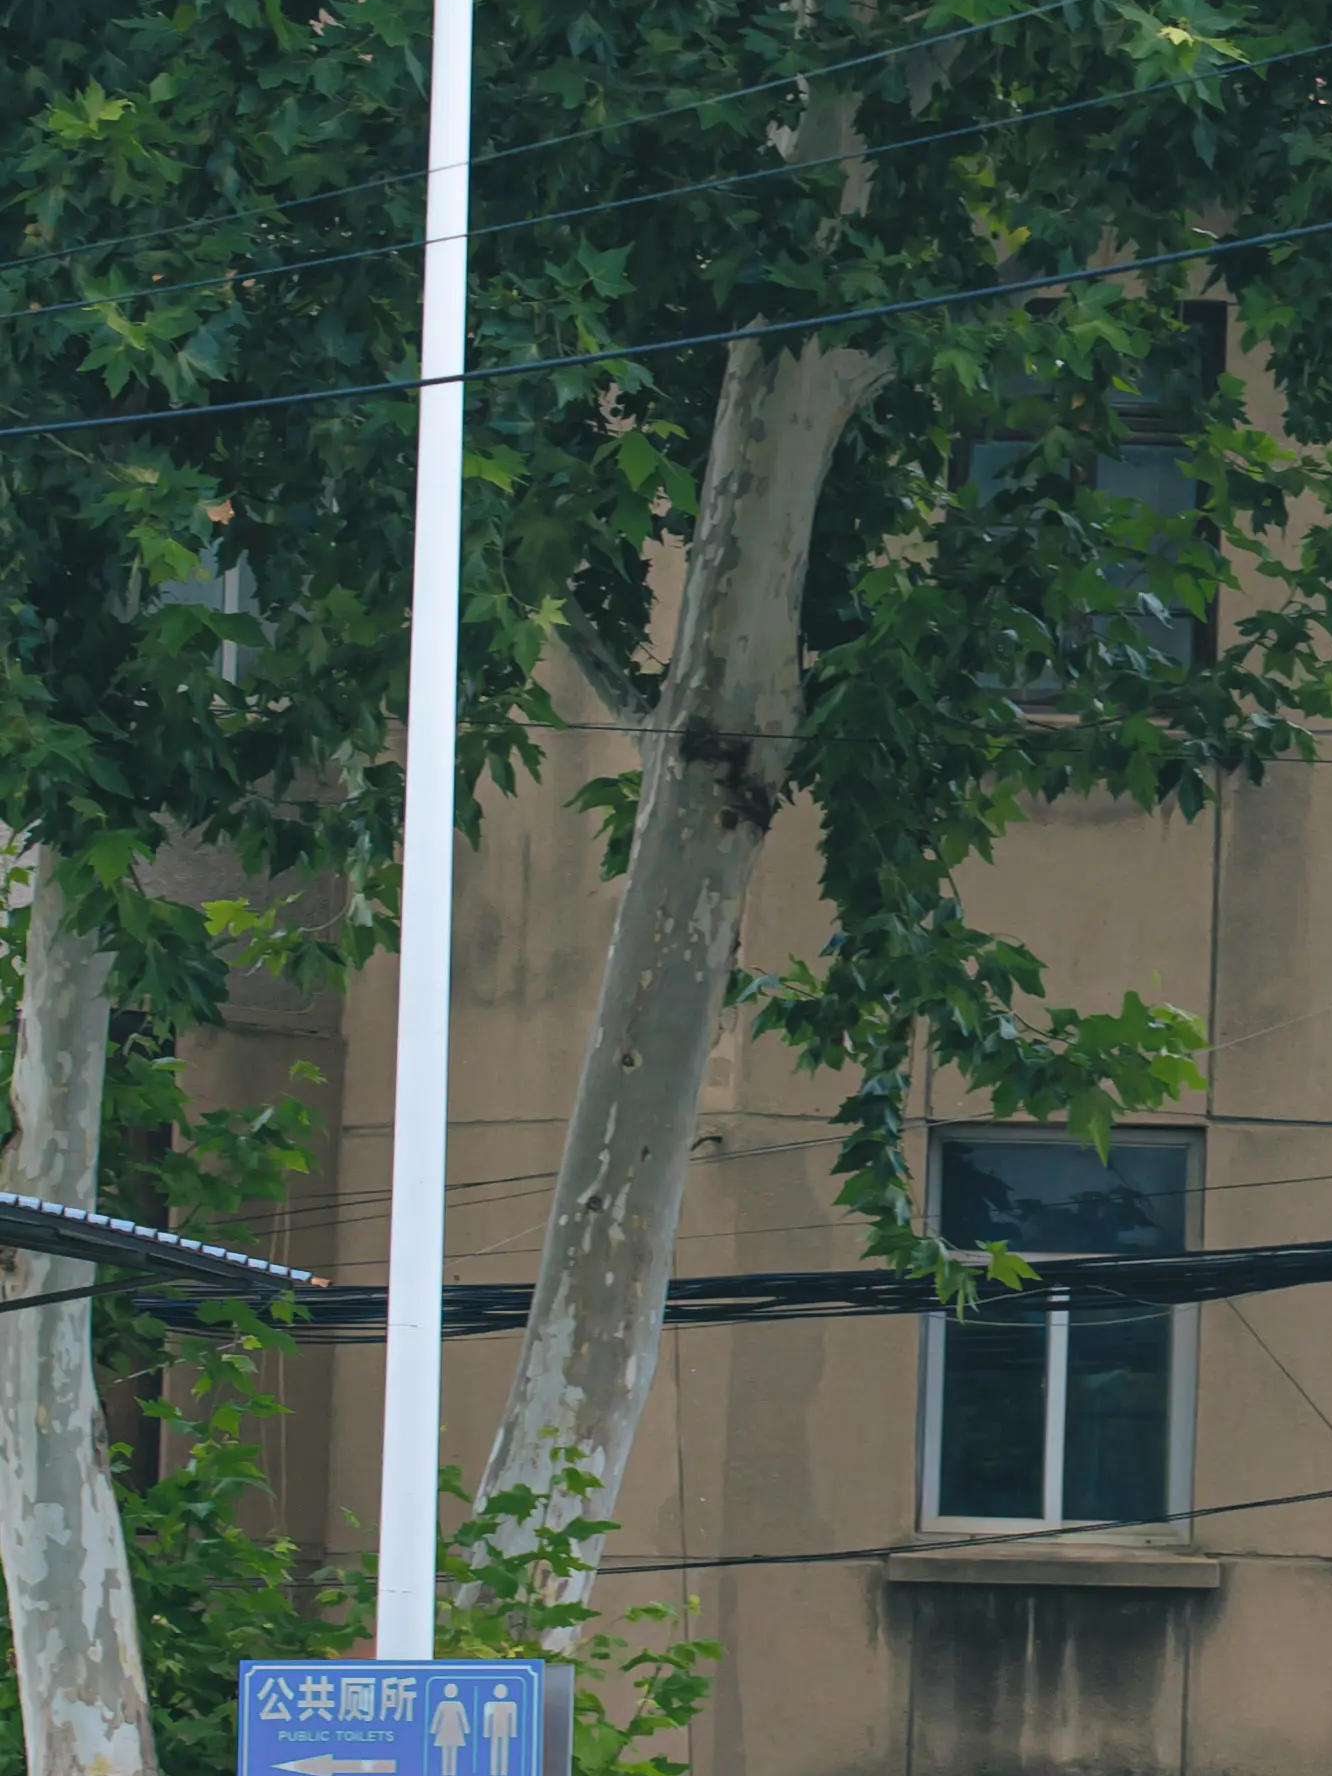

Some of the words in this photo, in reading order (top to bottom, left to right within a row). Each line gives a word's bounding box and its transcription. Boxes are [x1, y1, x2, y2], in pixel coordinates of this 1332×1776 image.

[257, 1675, 418, 1722] 公共厕所
[278, 1730, 329, 1742] PUBLIC
[336, 1730, 394, 1742] TOILETS
